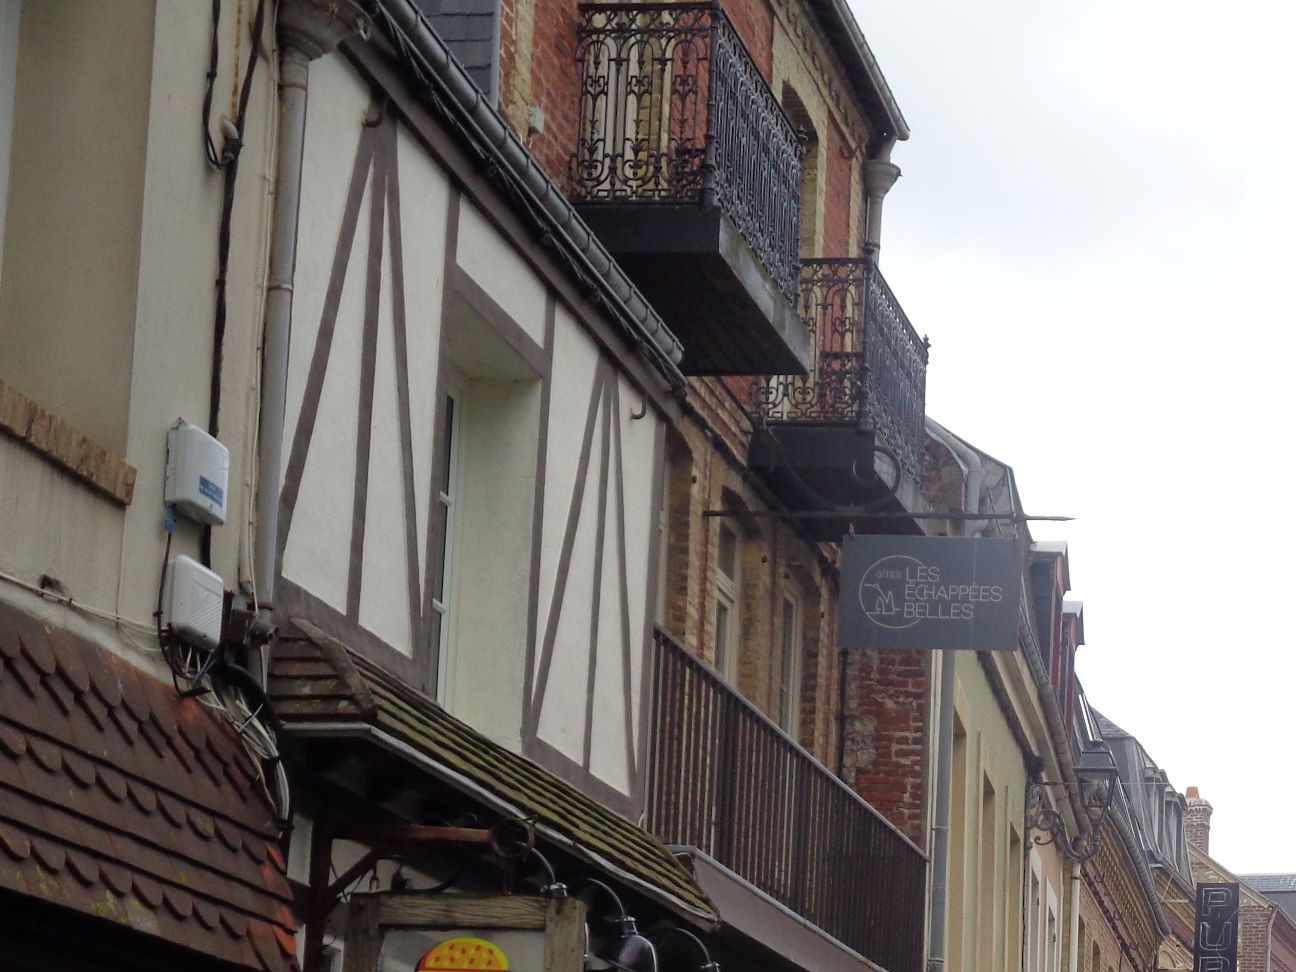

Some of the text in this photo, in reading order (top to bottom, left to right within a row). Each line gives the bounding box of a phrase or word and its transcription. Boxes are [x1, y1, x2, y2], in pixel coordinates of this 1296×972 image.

[905, 566, 941, 582] LES
[904, 581, 1003, 602] ÉCHAPPÉES
[903, 602, 975, 620] BELLES
